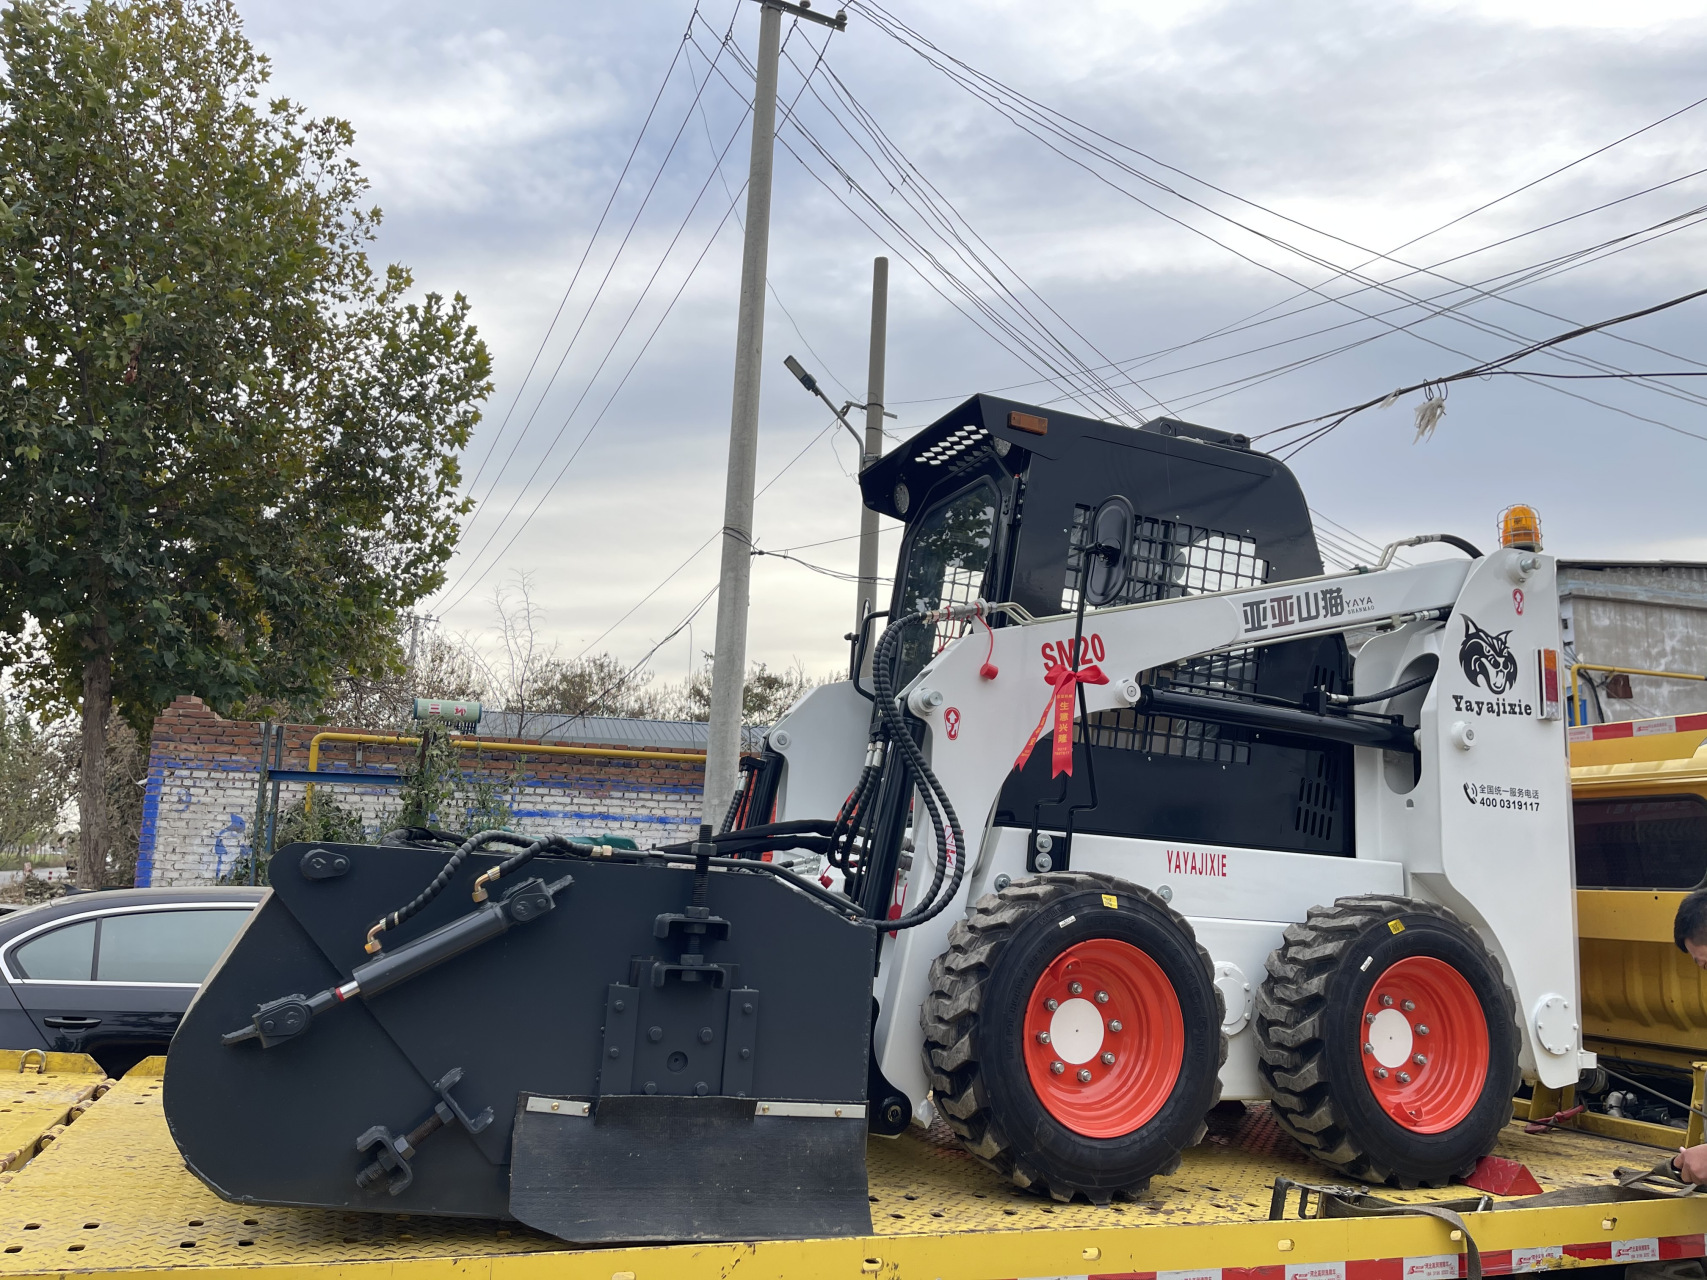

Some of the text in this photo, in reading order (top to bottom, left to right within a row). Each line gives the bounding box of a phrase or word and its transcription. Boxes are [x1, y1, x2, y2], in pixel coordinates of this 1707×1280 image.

[1243, 587, 1344, 633] 亚亚山猫
[1345, 596, 1373, 608] YAYA
[1452, 694, 1533, 717] Yayajixie
[1057, 701, 1070, 744] 生意兴隆
[1478, 784, 1540, 800] 全国统一服务电话
[1479, 797, 1540, 812] 400 0319117
[1166, 849, 1227, 877] YAYAJIXIE
